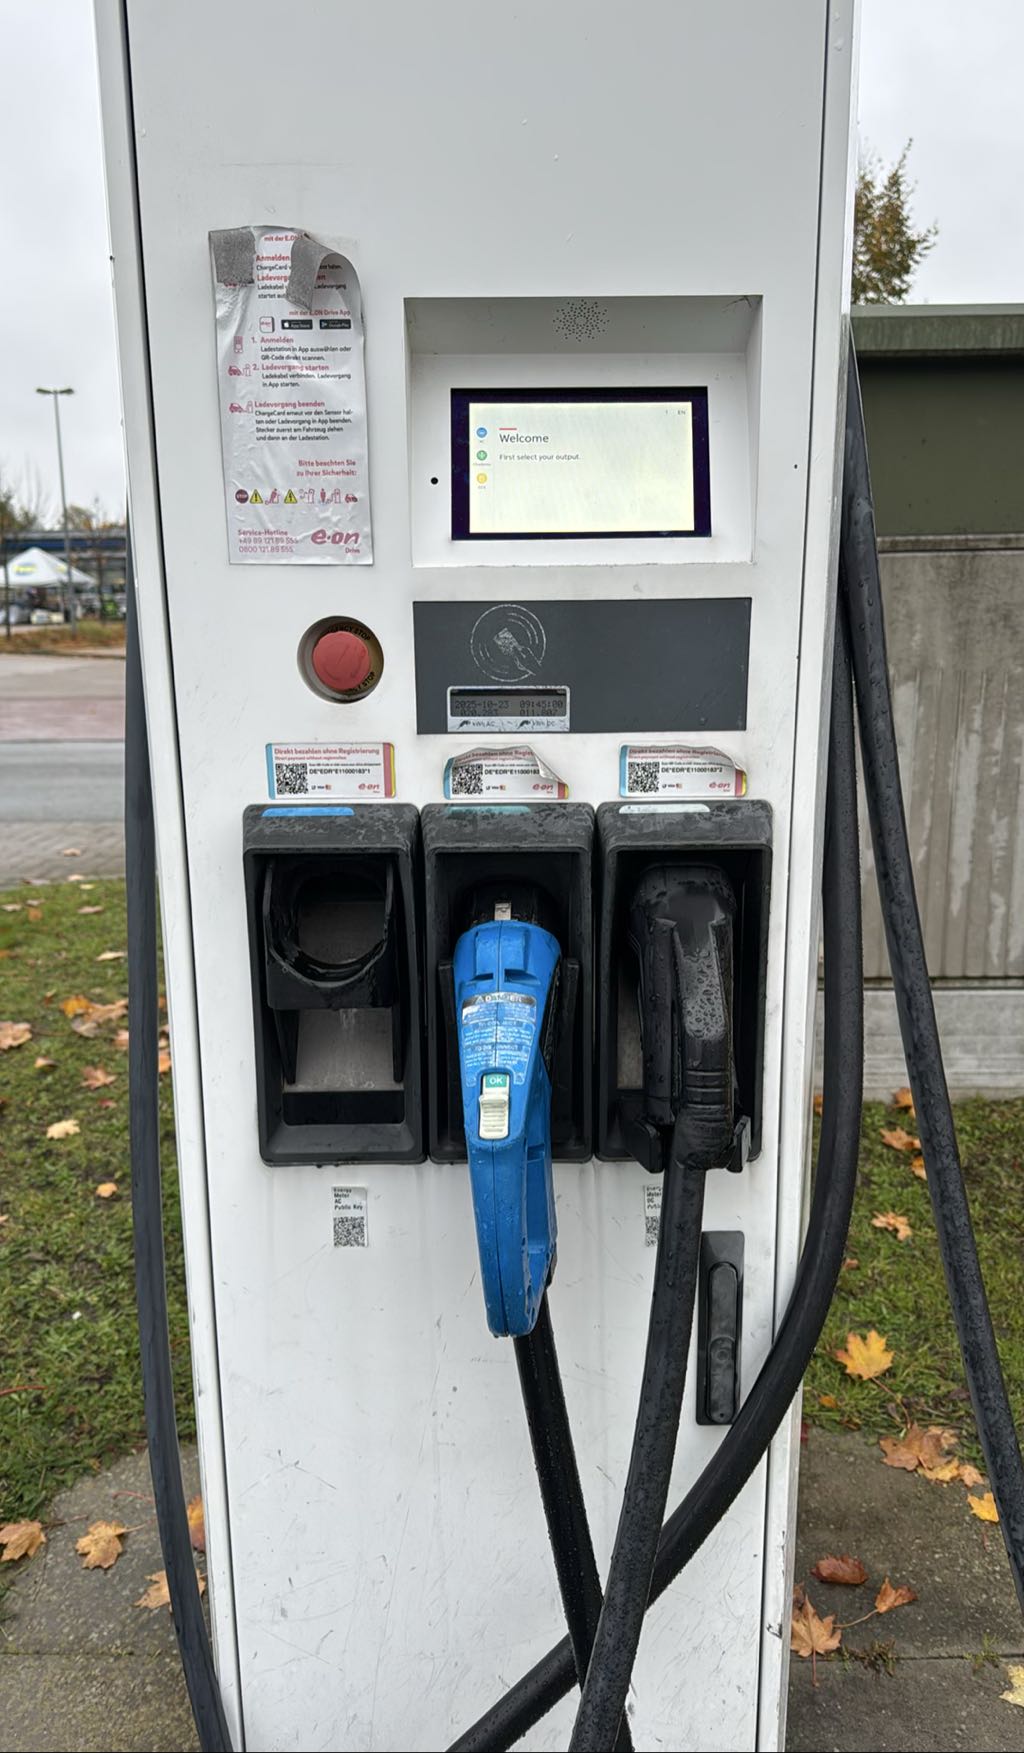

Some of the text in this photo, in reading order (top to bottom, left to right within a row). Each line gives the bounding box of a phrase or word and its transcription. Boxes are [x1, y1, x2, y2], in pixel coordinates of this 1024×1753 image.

[256, 254, 290, 262] Anmelden
[256, 264, 288, 272] ChargeCard
[256, 274, 289, 283] Ladevorg
[339, 309, 351, 317] App
[298, 345, 309, 353] App
[261, 364, 304, 372] Ladevorgang
[254, 400, 325, 409] Ladevorgang beenden
[278, 418, 311, 426] Ladevorgang
[499, 433, 549, 443] Welcome
[516, 453, 537, 461] select
[238, 529, 288, 537] Service-Hotline
[355, 627, 371, 641] STOP
[454, 700, 564, 709] 2025-10-23 09:45:00
[339, 747, 380, 756] Registrierung
[489, 1076, 503, 1085] OK
